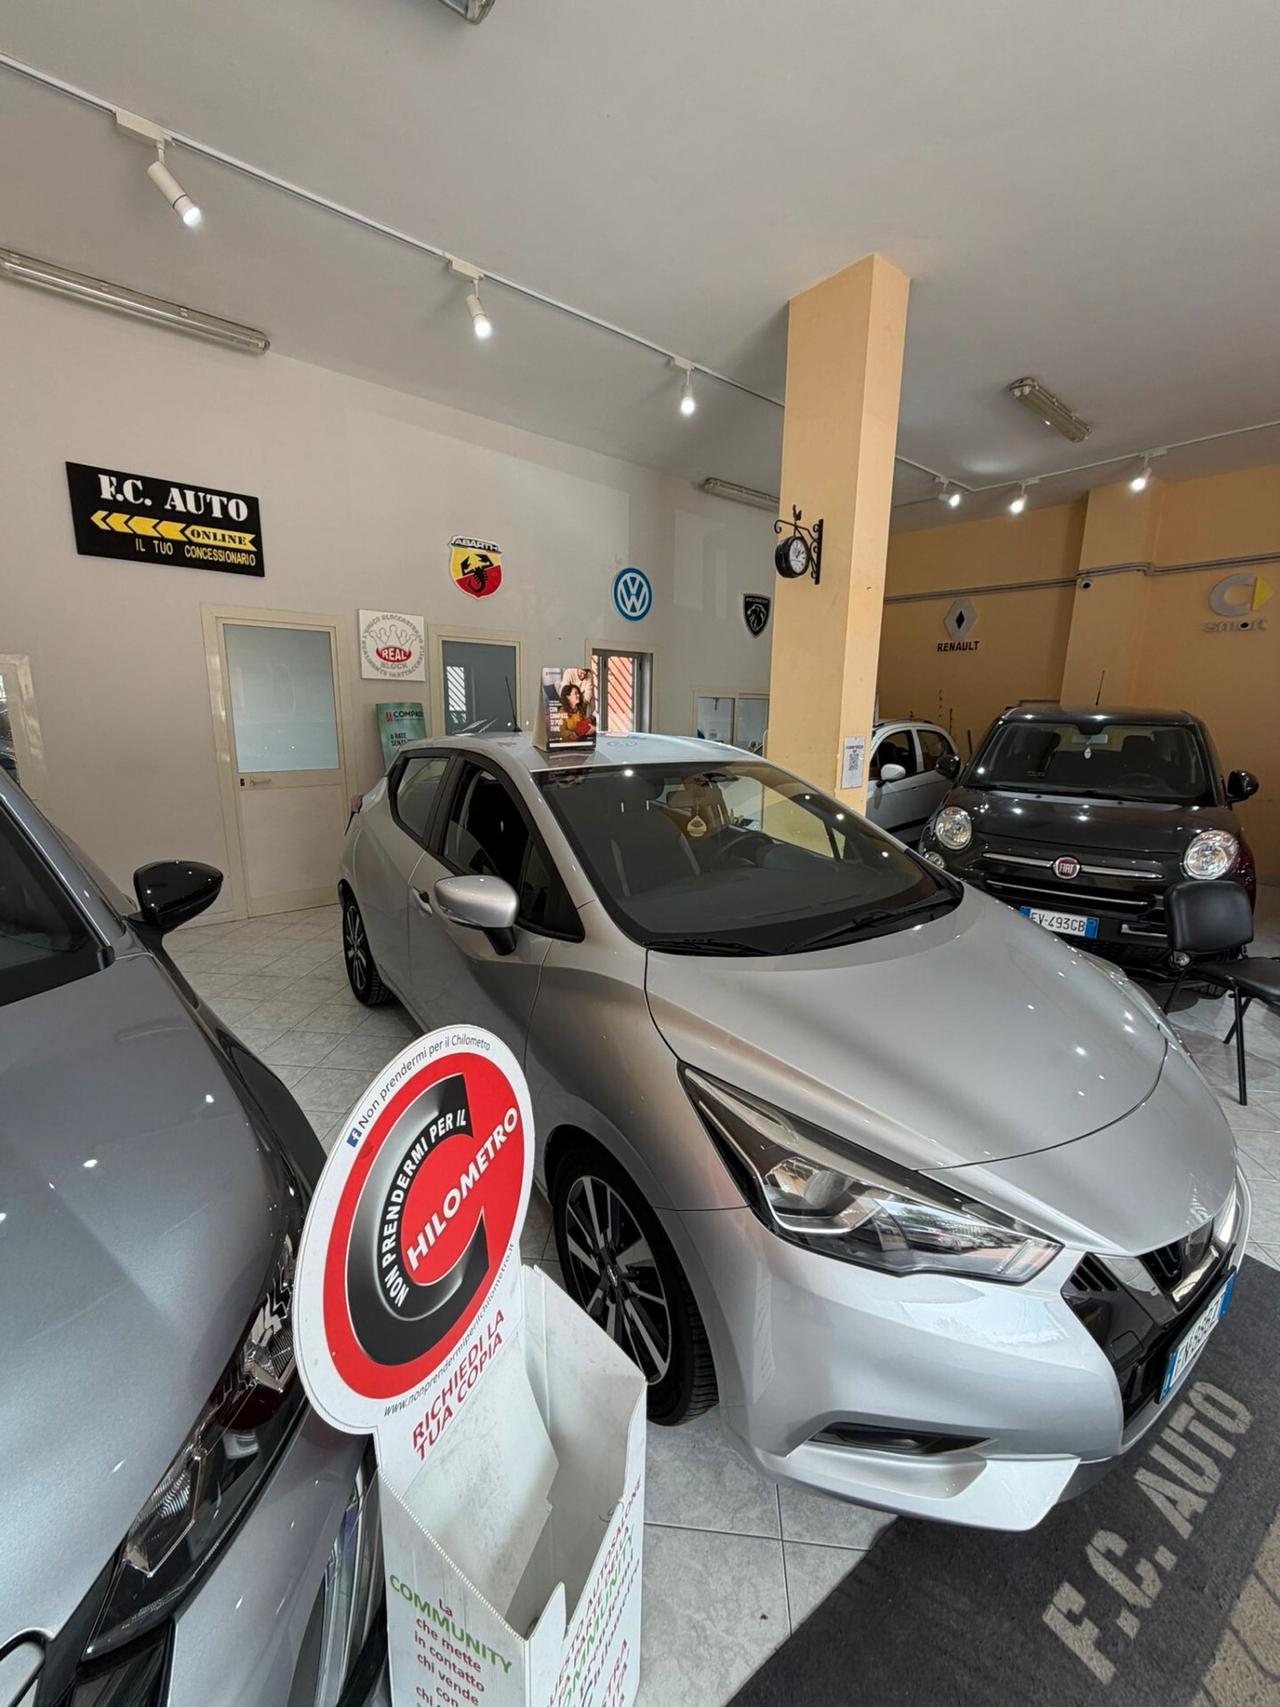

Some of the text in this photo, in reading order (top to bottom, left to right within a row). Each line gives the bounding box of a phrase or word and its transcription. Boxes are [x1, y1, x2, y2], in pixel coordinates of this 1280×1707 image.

[98, 474, 248, 521] F.C. AUTO
[135, 537, 256, 566] IL TUO CONCESSIONARIO
[191, 528, 247, 546] ONLINE
[381, 647, 408, 661] REAL
[936, 640, 980, 652] RENAULT
[1059, 862, 1075, 874] FIAT
[359, 1102, 379, 1129] Non
[381, 1047, 427, 1101] prendermi
[429, 1041, 443, 1056] per
[445, 1036, 450, 1048] il
[451, 1034, 491, 1051] Chilometro
[382, 1109, 467, 1308] NON PRENDERMI PER IL
[413, 1309, 505, 1450] RICHIEDI LA
[416, 1332, 503, 1461] TUA COPIA
[1042, 1528, 1178, 1686] F.C.
[1134, 1381, 1253, 1540] AUTO
[390, 1574, 512, 1674] COMMUNITY
[439, 1598, 453, 1617] La
[414, 1630, 485, 1692] in contatto
[416, 1618, 481, 1672] che mette
[415, 1686, 433, 1707] chi
[417, 1654, 479, 1706] chi vende
[436, 1687, 459, 1707] con
